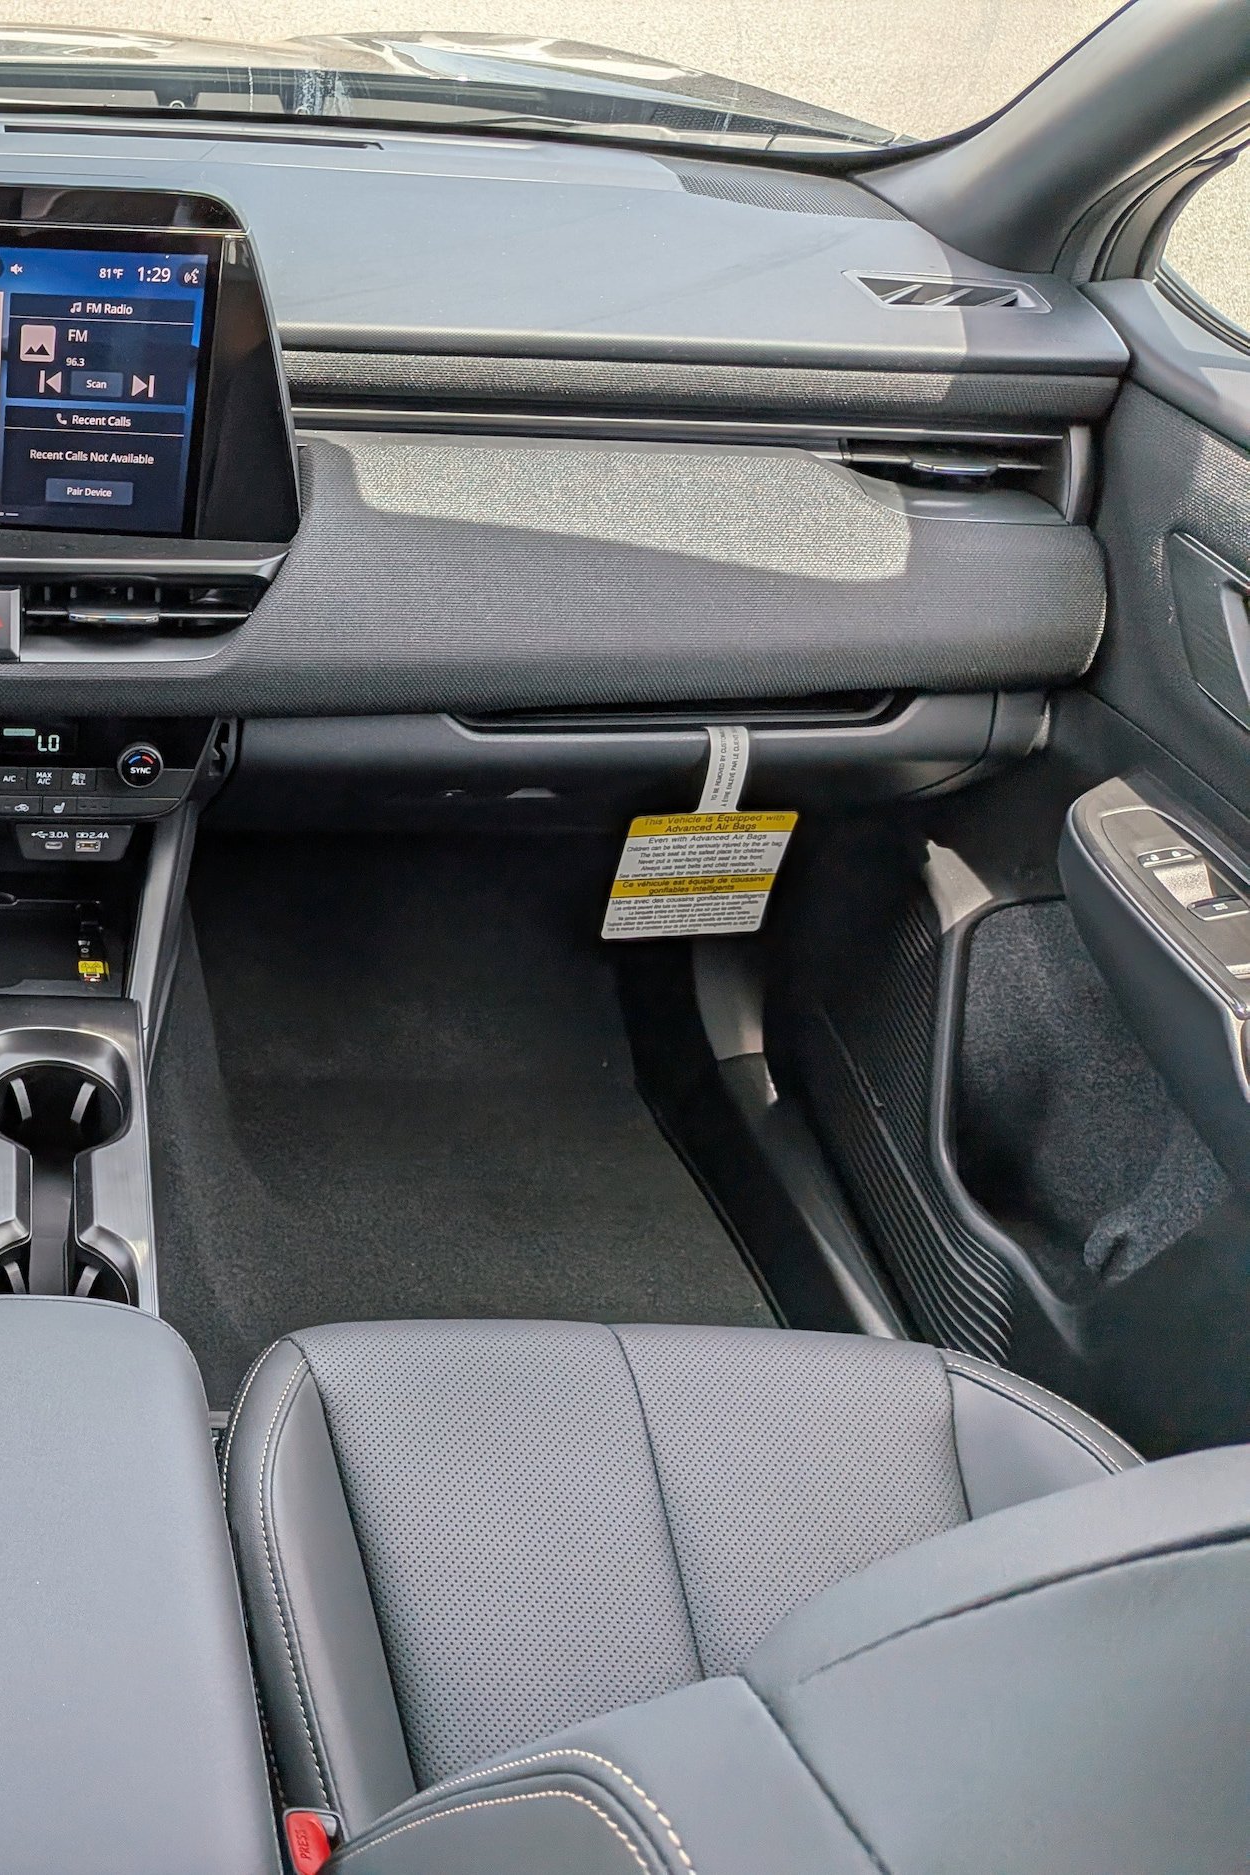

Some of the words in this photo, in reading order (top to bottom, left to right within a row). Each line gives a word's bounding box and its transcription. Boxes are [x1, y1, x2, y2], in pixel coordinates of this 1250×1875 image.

[99, 268, 124, 279] 81°F
[138, 266, 172, 283] 1:29
[86, 304, 103, 314] FM
[104, 304, 133, 315] Radio
[68, 329, 88, 342] FM
[66, 357, 85, 368] 96.3
[86, 379, 107, 390] Scan
[72, 415, 105, 426] Recent
[108, 416, 132, 427] Calls
[30, 449, 63, 460] Recent
[65, 450, 88, 462] Calls
[90, 451, 108, 462] Not
[110, 452, 154, 465] Available
[67, 486, 82, 497] Pair
[85, 487, 112, 498] Device
[38, 734, 60, 752] LO
[730, 760, 738, 771] PAR
[645, 818, 662, 826] This
[668, 816, 702, 824] Vehicle
[718, 814, 762, 824] Equipped
[664, 824, 712, 832] Advanced
[732, 822, 756, 830] Bags
[690, 834, 730, 842] Advanced
[638, 879, 670, 887] véhicule
[672, 878, 685, 886] est
[688, 877, 714, 886] équipé
[648, 886, 689, 894] gonflables
[692, 884, 734, 892] intelligents
[295, 1829, 312, 1860] PRESS
